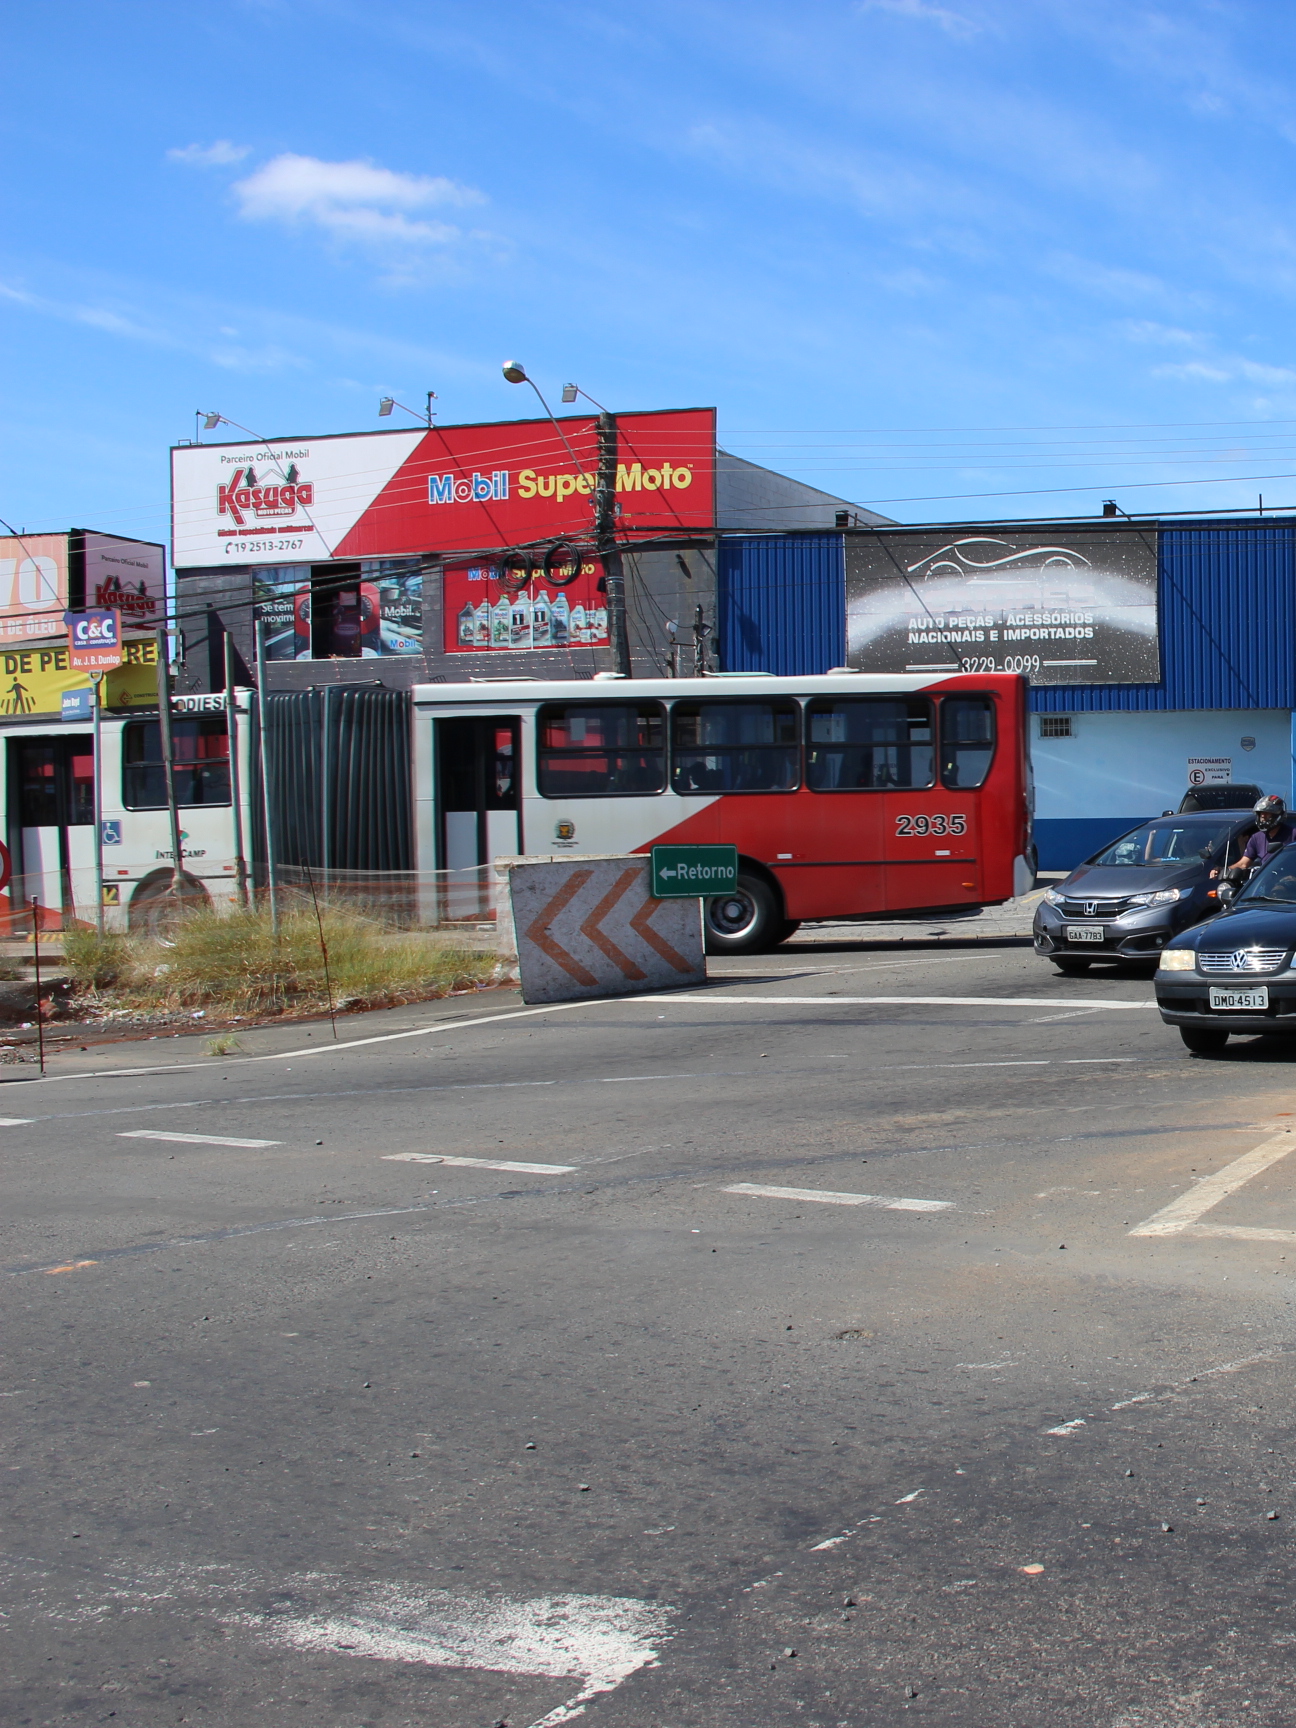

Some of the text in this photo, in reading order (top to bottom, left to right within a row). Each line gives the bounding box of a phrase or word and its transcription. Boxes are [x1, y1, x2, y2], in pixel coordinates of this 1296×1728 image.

[220, 449, 310, 464] Parceiro Oficial Mobil
[428, 470, 509, 505] Mobil
[517, 469, 599, 503] Supe
[615, 463, 692, 492] Moto
[217, 467, 314, 526] Kasuga
[234, 539, 303, 553] 19 2513-2767
[101, 555, 120, 564] Parceiro
[120, 558, 136, 567] Oficial
[261, 604, 294, 613] Se tem
[7, 620, 22, 636] DE
[26, 615, 56, 635] ÓLEO
[76, 619, 113, 640] C&C
[908, 617, 944, 630] AUTO
[949, 615, 994, 630] PEÇAS
[1006, 611, 1094, 626] ACESSÓRIOS
[89, 637, 118, 645] construção
[390, 639, 417, 649] Mobil
[907, 626, 1094, 644] NACIONAIS E IMPORTADOS
[5, 653, 33, 675] DE
[73, 654, 121, 667] Av. J. B. Dunlop
[961, 654, 1040, 673] 3229-0099
[1193, 772, 1201, 783] E
[895, 814, 967, 837] 2935
[676, 862, 735, 880] Retorno
